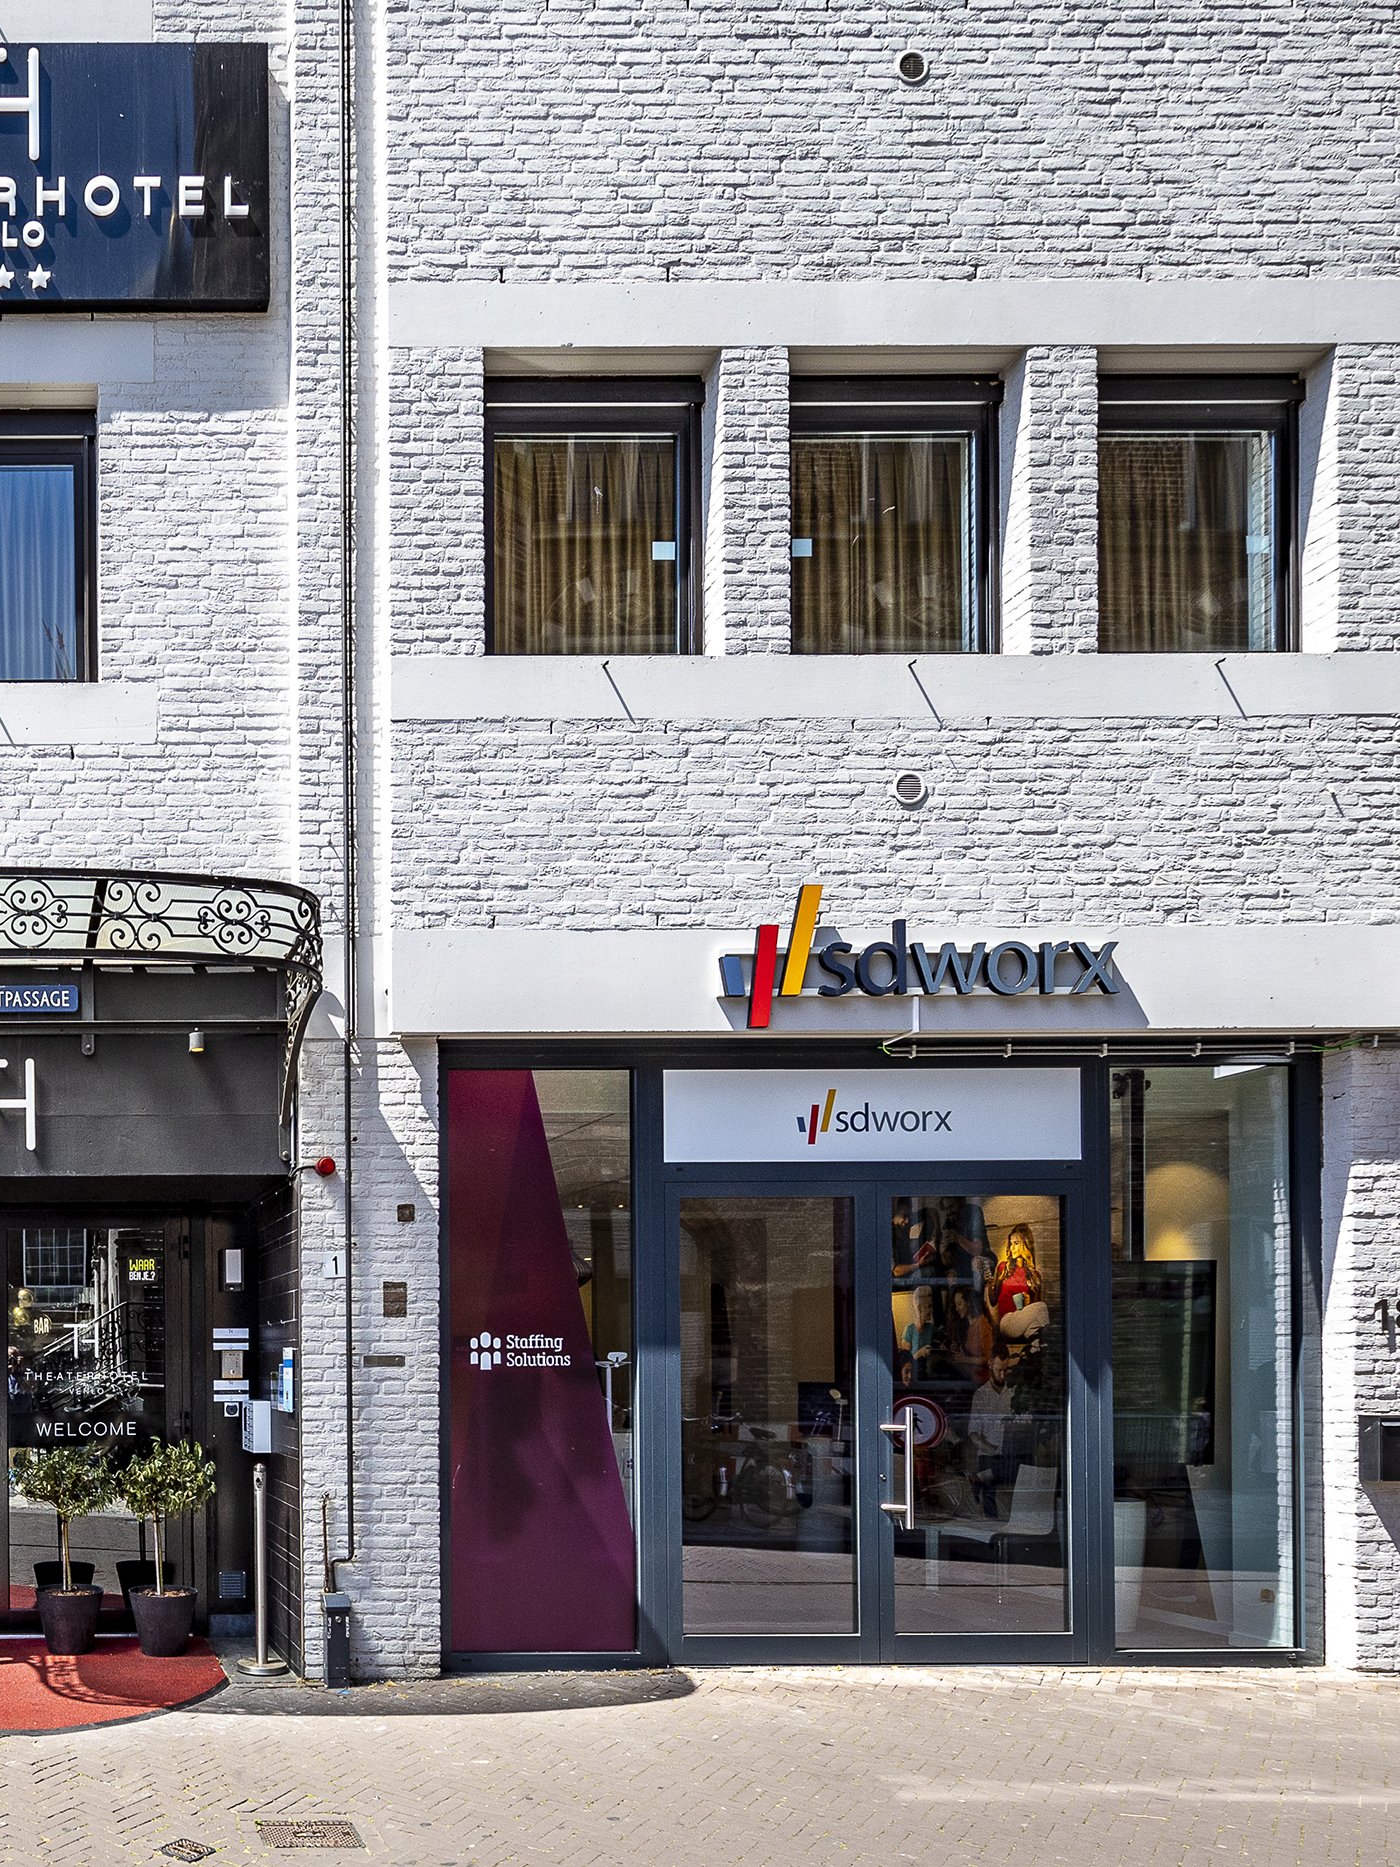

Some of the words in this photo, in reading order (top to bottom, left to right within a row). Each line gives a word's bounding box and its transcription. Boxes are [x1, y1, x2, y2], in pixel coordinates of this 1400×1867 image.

[817, 919, 1120, 997] sdworx
[835, 1102, 953, 1133] sdworx
[128, 1258, 155, 1272] WAAR
[332, 1255, 339, 1275] 1
[33, 1316, 50, 1335] BAR
[506, 1334, 564, 1352] Staffing
[506, 1352, 571, 1367] Solutions
[36, 1421, 137, 1437] WELCOME
